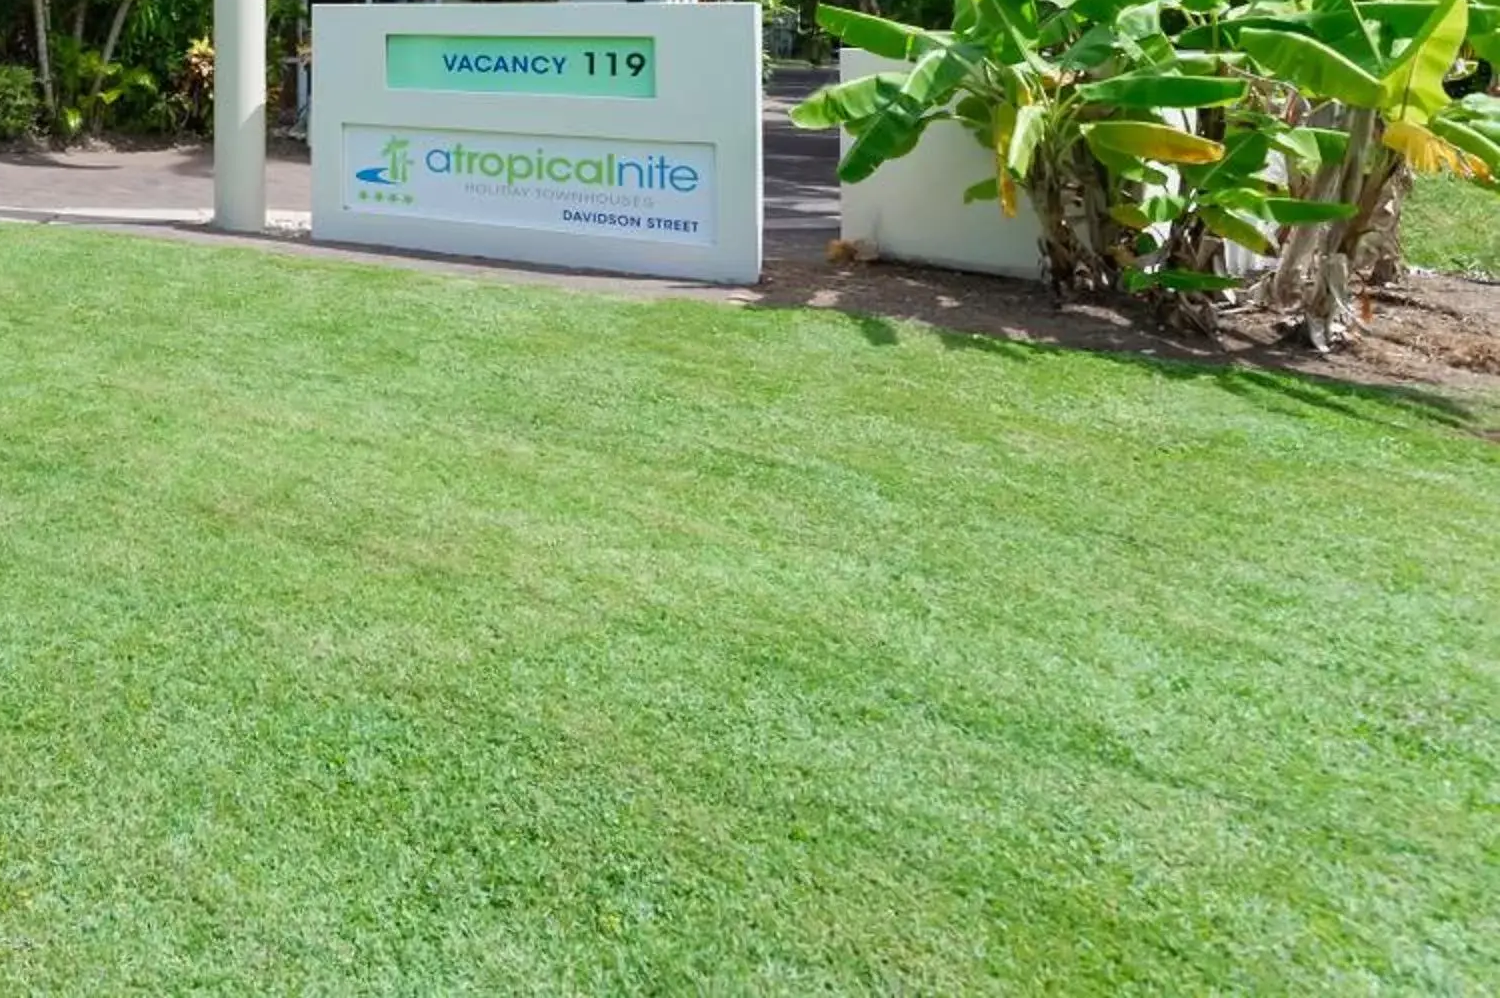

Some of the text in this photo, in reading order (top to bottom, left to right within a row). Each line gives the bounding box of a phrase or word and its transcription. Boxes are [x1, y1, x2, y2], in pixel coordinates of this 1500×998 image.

[443, 51, 646, 77] VACANCY 119
[425, 143, 699, 192] atropicalnite
[464, 182, 655, 208] HOLIDAY TOWNHOUSES
[562, 209, 699, 233] DAVIDSON STREET
